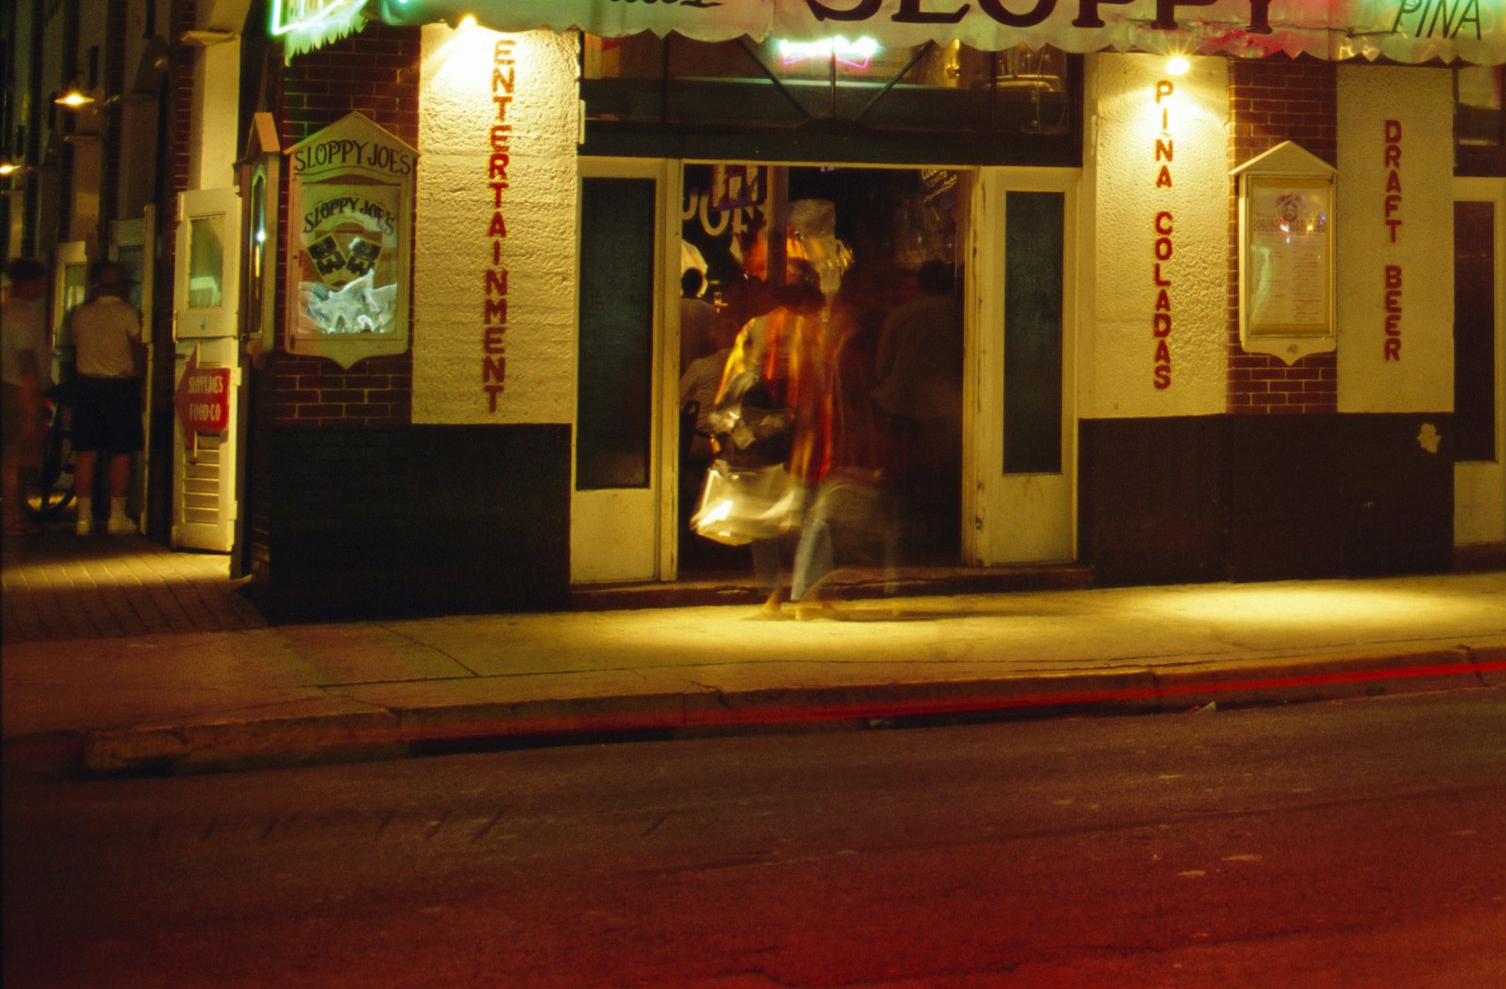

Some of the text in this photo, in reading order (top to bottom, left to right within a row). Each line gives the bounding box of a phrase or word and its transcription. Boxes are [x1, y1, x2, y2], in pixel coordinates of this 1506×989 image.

[294, 140, 411, 176] SLOPPY JOE'S
[303, 196, 396, 237] SLOPPY JOE'S
[481, 38, 517, 413] ENTERTAINMENT
[1153, 80, 1174, 391] PIÑA COLADAS
[1384, 119, 1402, 362] DRAFT BEER
